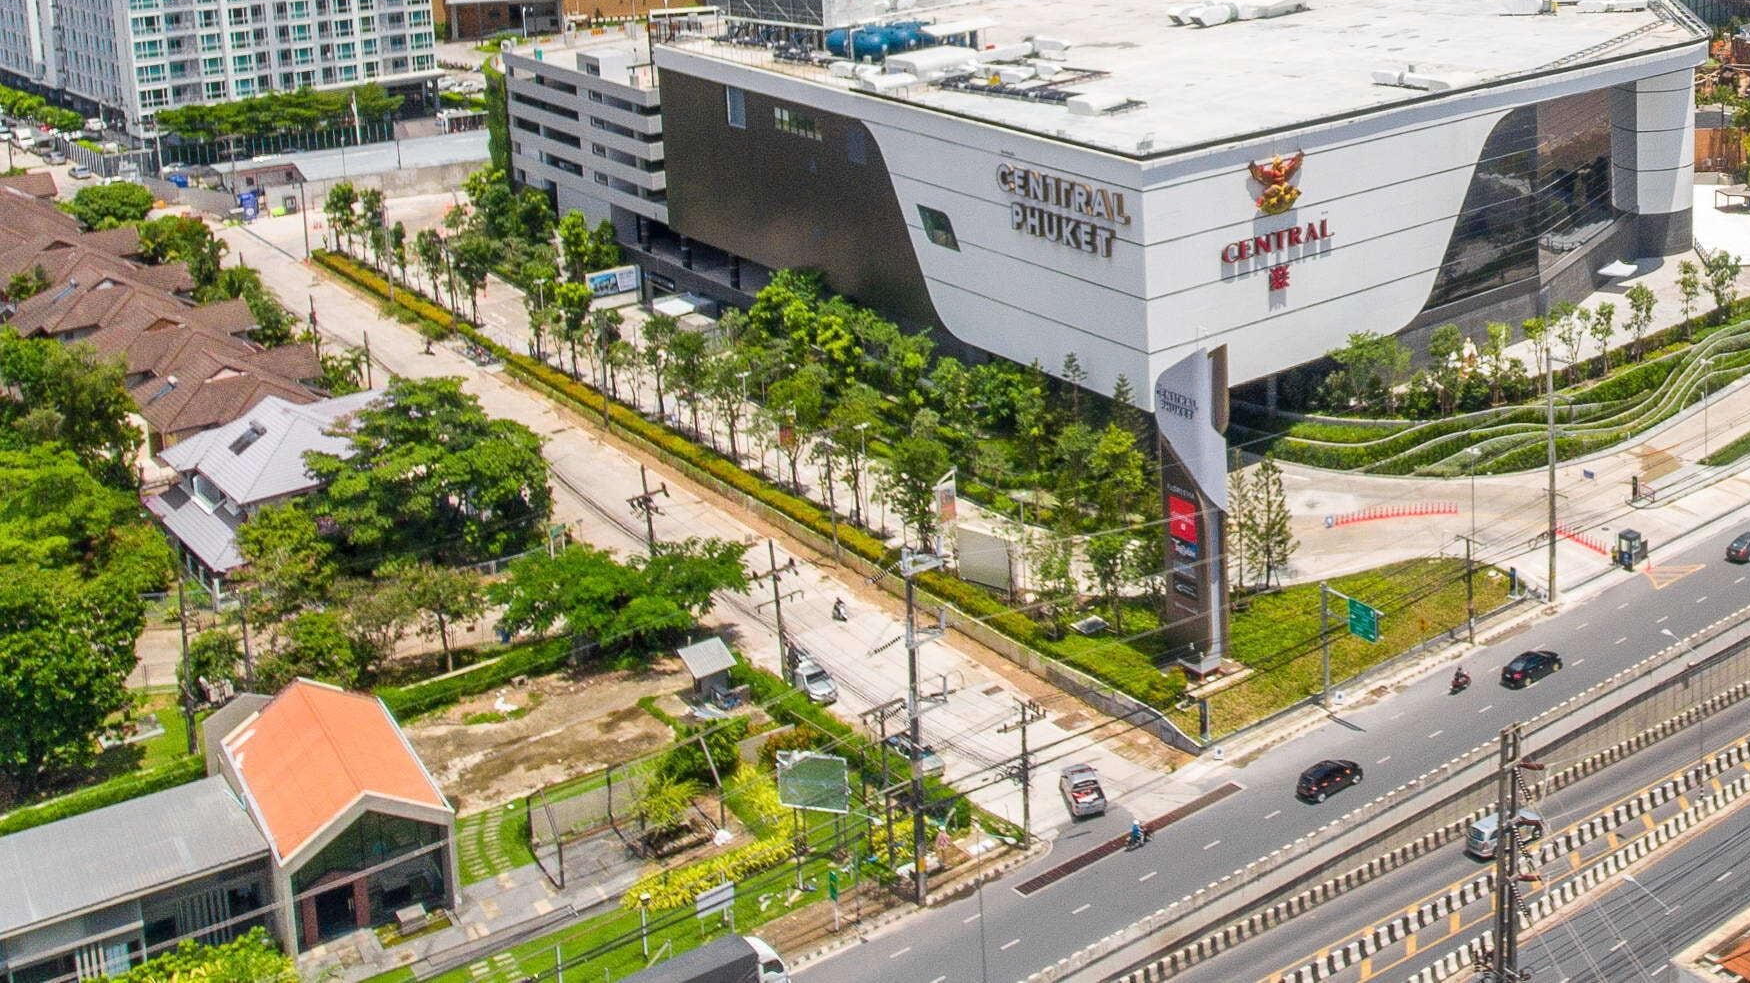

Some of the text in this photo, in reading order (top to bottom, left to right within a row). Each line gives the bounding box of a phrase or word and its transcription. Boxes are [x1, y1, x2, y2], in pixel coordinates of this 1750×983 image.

[997, 163, 1131, 225] CENTRAL
[1011, 203, 1116, 258] PHUKET
[1221, 219, 1334, 264] CENTRAL
